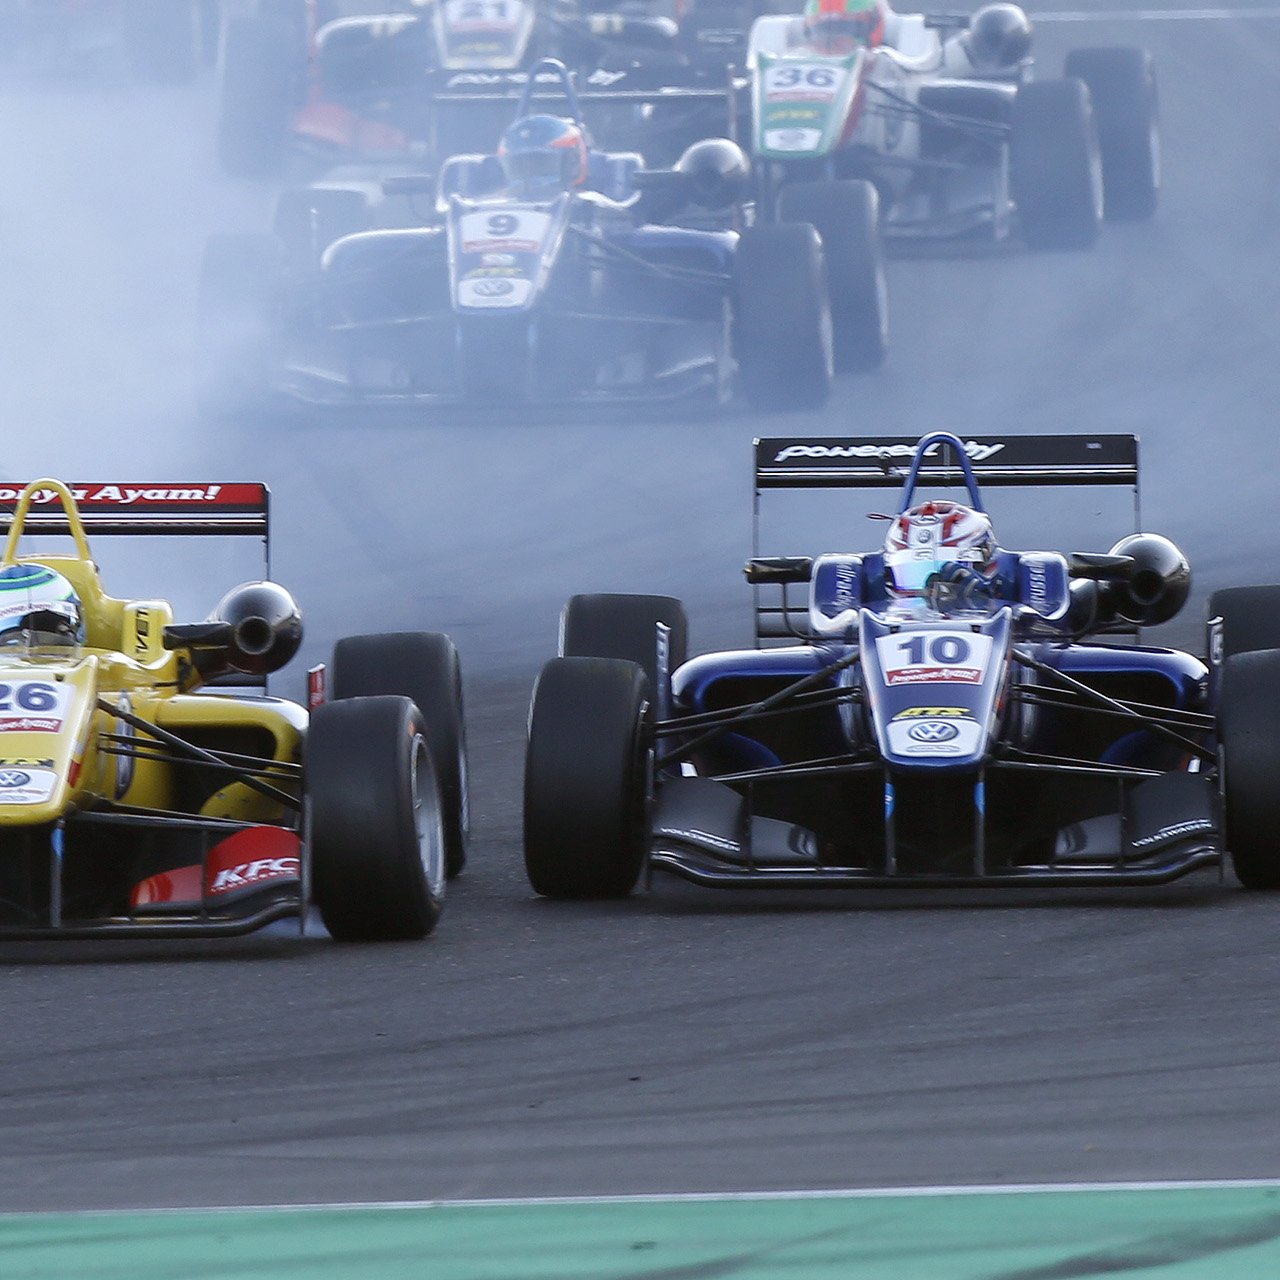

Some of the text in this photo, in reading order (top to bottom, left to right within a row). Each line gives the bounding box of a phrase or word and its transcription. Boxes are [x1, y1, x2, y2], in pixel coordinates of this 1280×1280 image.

[773, 67, 838, 88] 36
[487, 214, 520, 237] 9
[91, 484, 222, 504] Ayam!
[897, 635, 971, 665] 10
[213, 857, 300, 888] KFC
